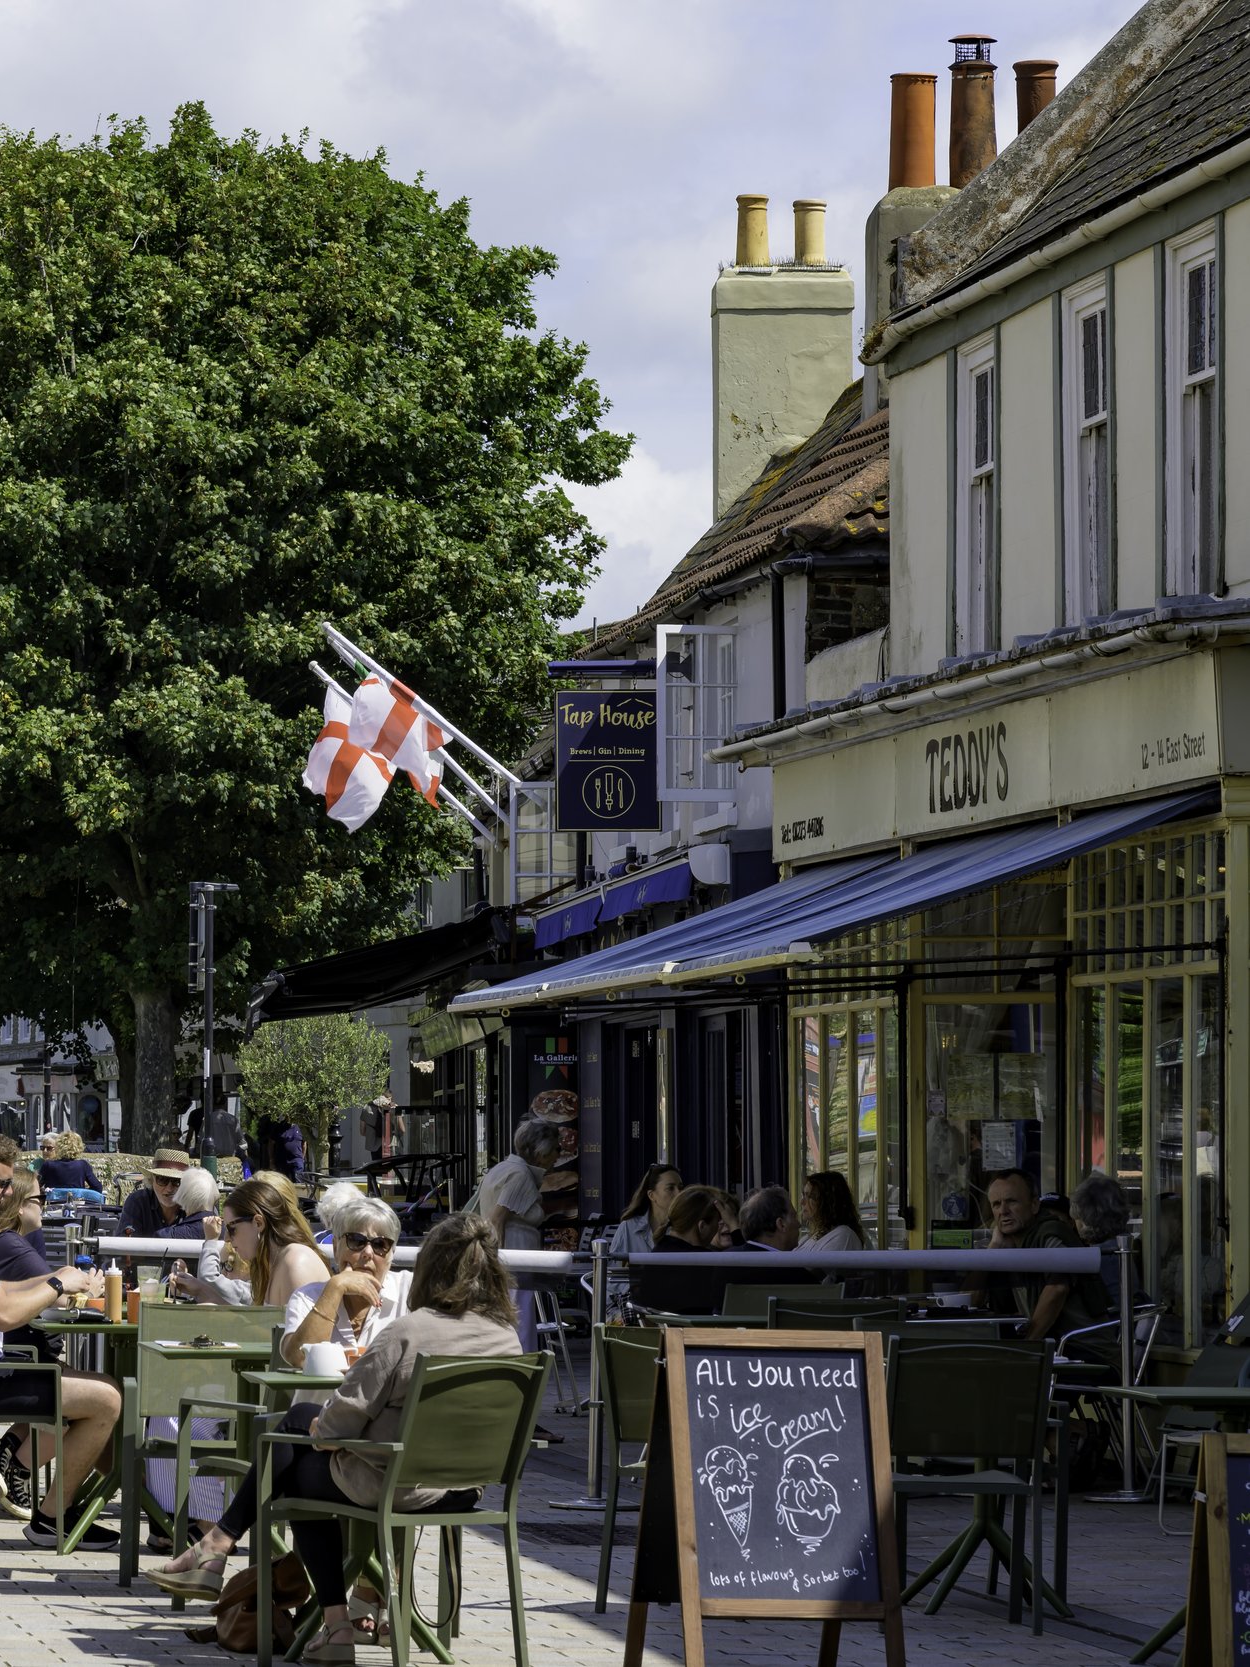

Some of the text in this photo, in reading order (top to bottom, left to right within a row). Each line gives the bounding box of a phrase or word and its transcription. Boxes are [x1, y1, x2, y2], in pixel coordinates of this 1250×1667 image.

[559, 703, 657, 730] Tap House
[570, 747, 646, 756] Brews Gin Dining
[1141, 743, 1149, 770] 12
[1157, 739, 1164, 766] 14
[1166, 737, 1181, 764] East
[1183, 732, 1206, 760] Street
[925, 721, 1009, 814] TEDDY'S
[696, 1358, 737, 1386] All
[799, 1358, 858, 1388] need
[729, 1403, 772, 1433] ice
[709, 1571, 731, 1587] lots
[733, 1571, 746, 1588] of
[750, 1568, 795, 1587] flavours
